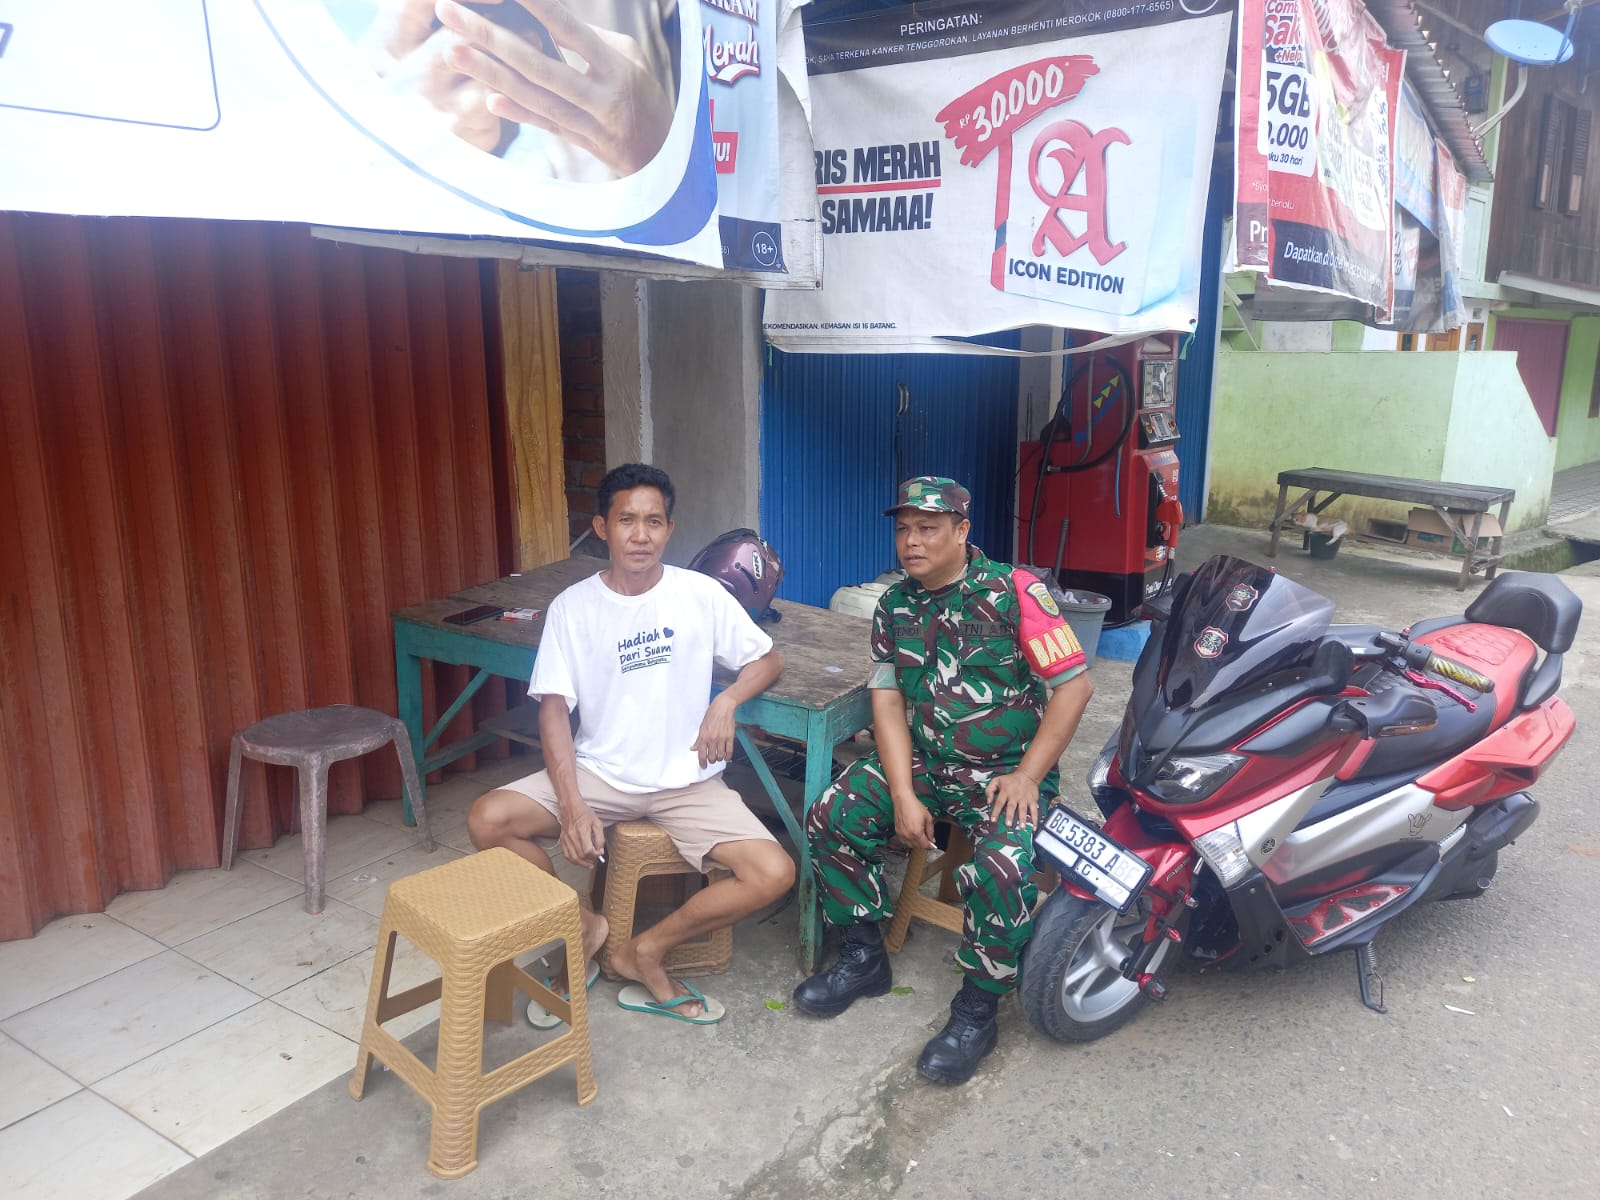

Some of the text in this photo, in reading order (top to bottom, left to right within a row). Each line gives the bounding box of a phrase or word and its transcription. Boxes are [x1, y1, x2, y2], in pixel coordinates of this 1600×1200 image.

[835, 49, 871, 61] TERKENA
[871, 44, 905, 56] KANKER
[906, 37, 970, 52] TENGGOROKAN.
[972, 27, 1009, 42] LAYANAN
[1010, 19, 1054, 36] BERHENTI
[1055, 11, 1102, 27] MEROKOK
[1103, 0, 1174, 22] (0800-177-6565)
[900, 13, 983, 37] PERINGATAN:
[959, 114, 971, 129] RP
[853, 140, 941, 183] MERAH
[1279, 153, 1289, 163] 30
[1290, 154, 1303, 166] hari
[821, 193, 934, 235] SAMAAA!
[755, 243, 774, 255] 18+
[1284, 241, 1322, 264] Dapatkan
[1008, 258, 1125, 295] ICON EDITION
[820, 322, 851, 330] KEMASAN
[618, 628, 660, 652] Hadiah
[965, 623, 983, 634] TNI
[619, 648, 640, 665] Dari
[1049, 812, 1069, 834] BG
[1065, 824, 1107, 860] 5383
